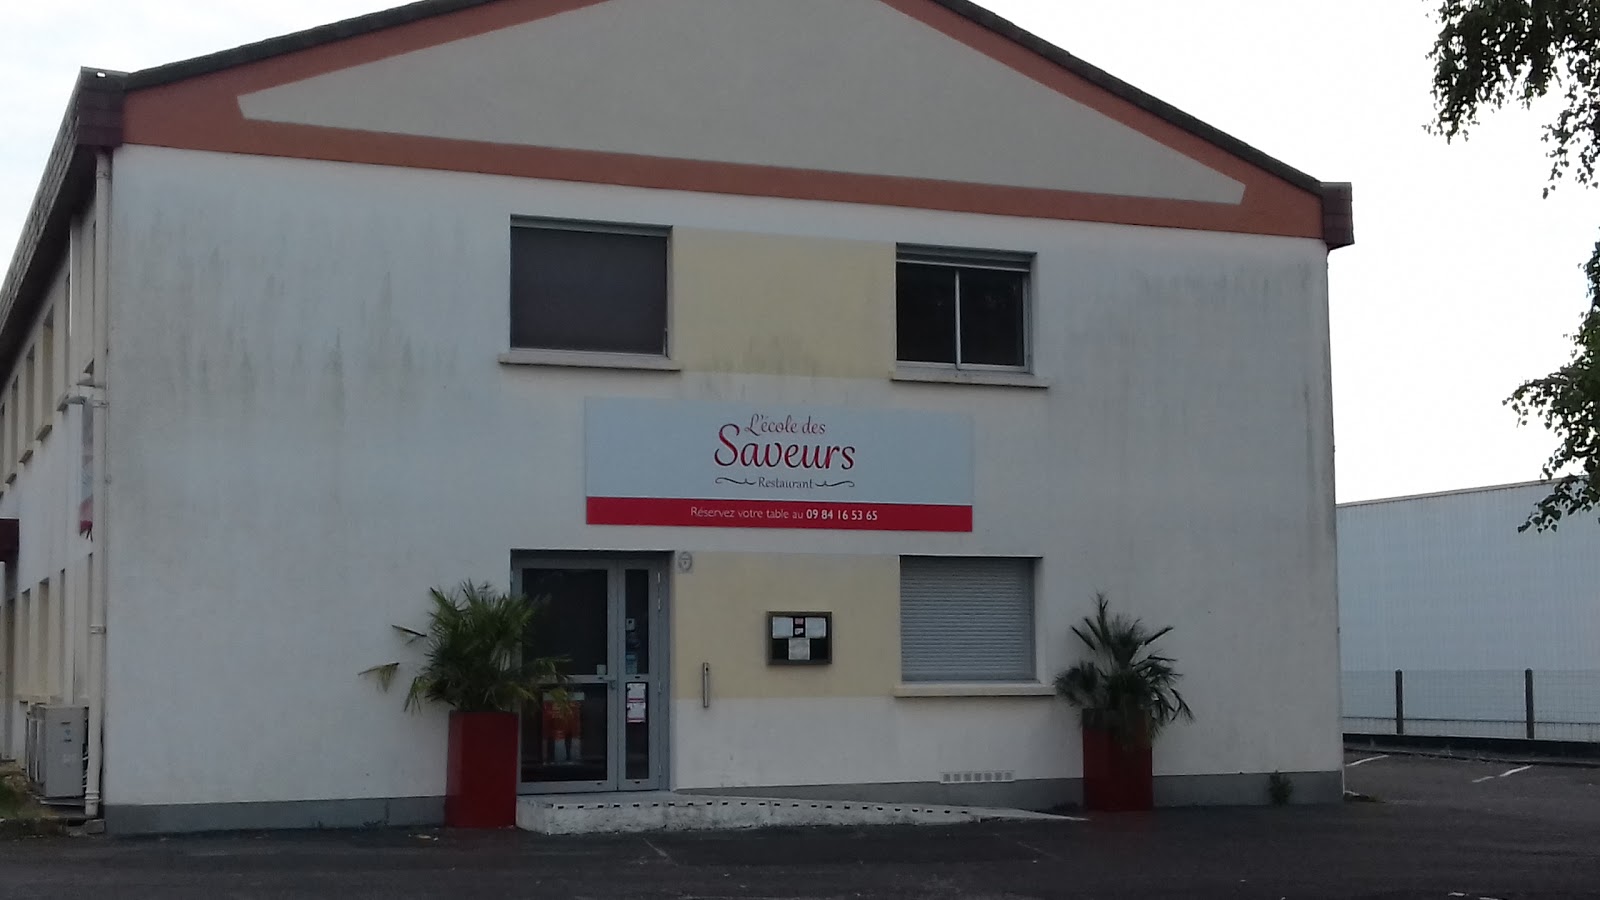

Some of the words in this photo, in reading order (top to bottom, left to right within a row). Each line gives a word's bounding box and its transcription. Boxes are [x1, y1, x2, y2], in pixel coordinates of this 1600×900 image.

[744, 413, 797, 436] L'école
[802, 416, 826, 434] des
[714, 423, 856, 470] Saveurs
[758, 476, 814, 489] Restaurant
[690, 506, 735, 518] Réservez
[738, 509, 763, 518] votre
[766, 508, 789, 519] table
[792, 511, 804, 520] au
[806, 508, 818, 519] 09
[821, 509, 833, 520] 84
[837, 509, 848, 520] 16
[851, 510, 863, 521] 53
[866, 510, 878, 521] 65
